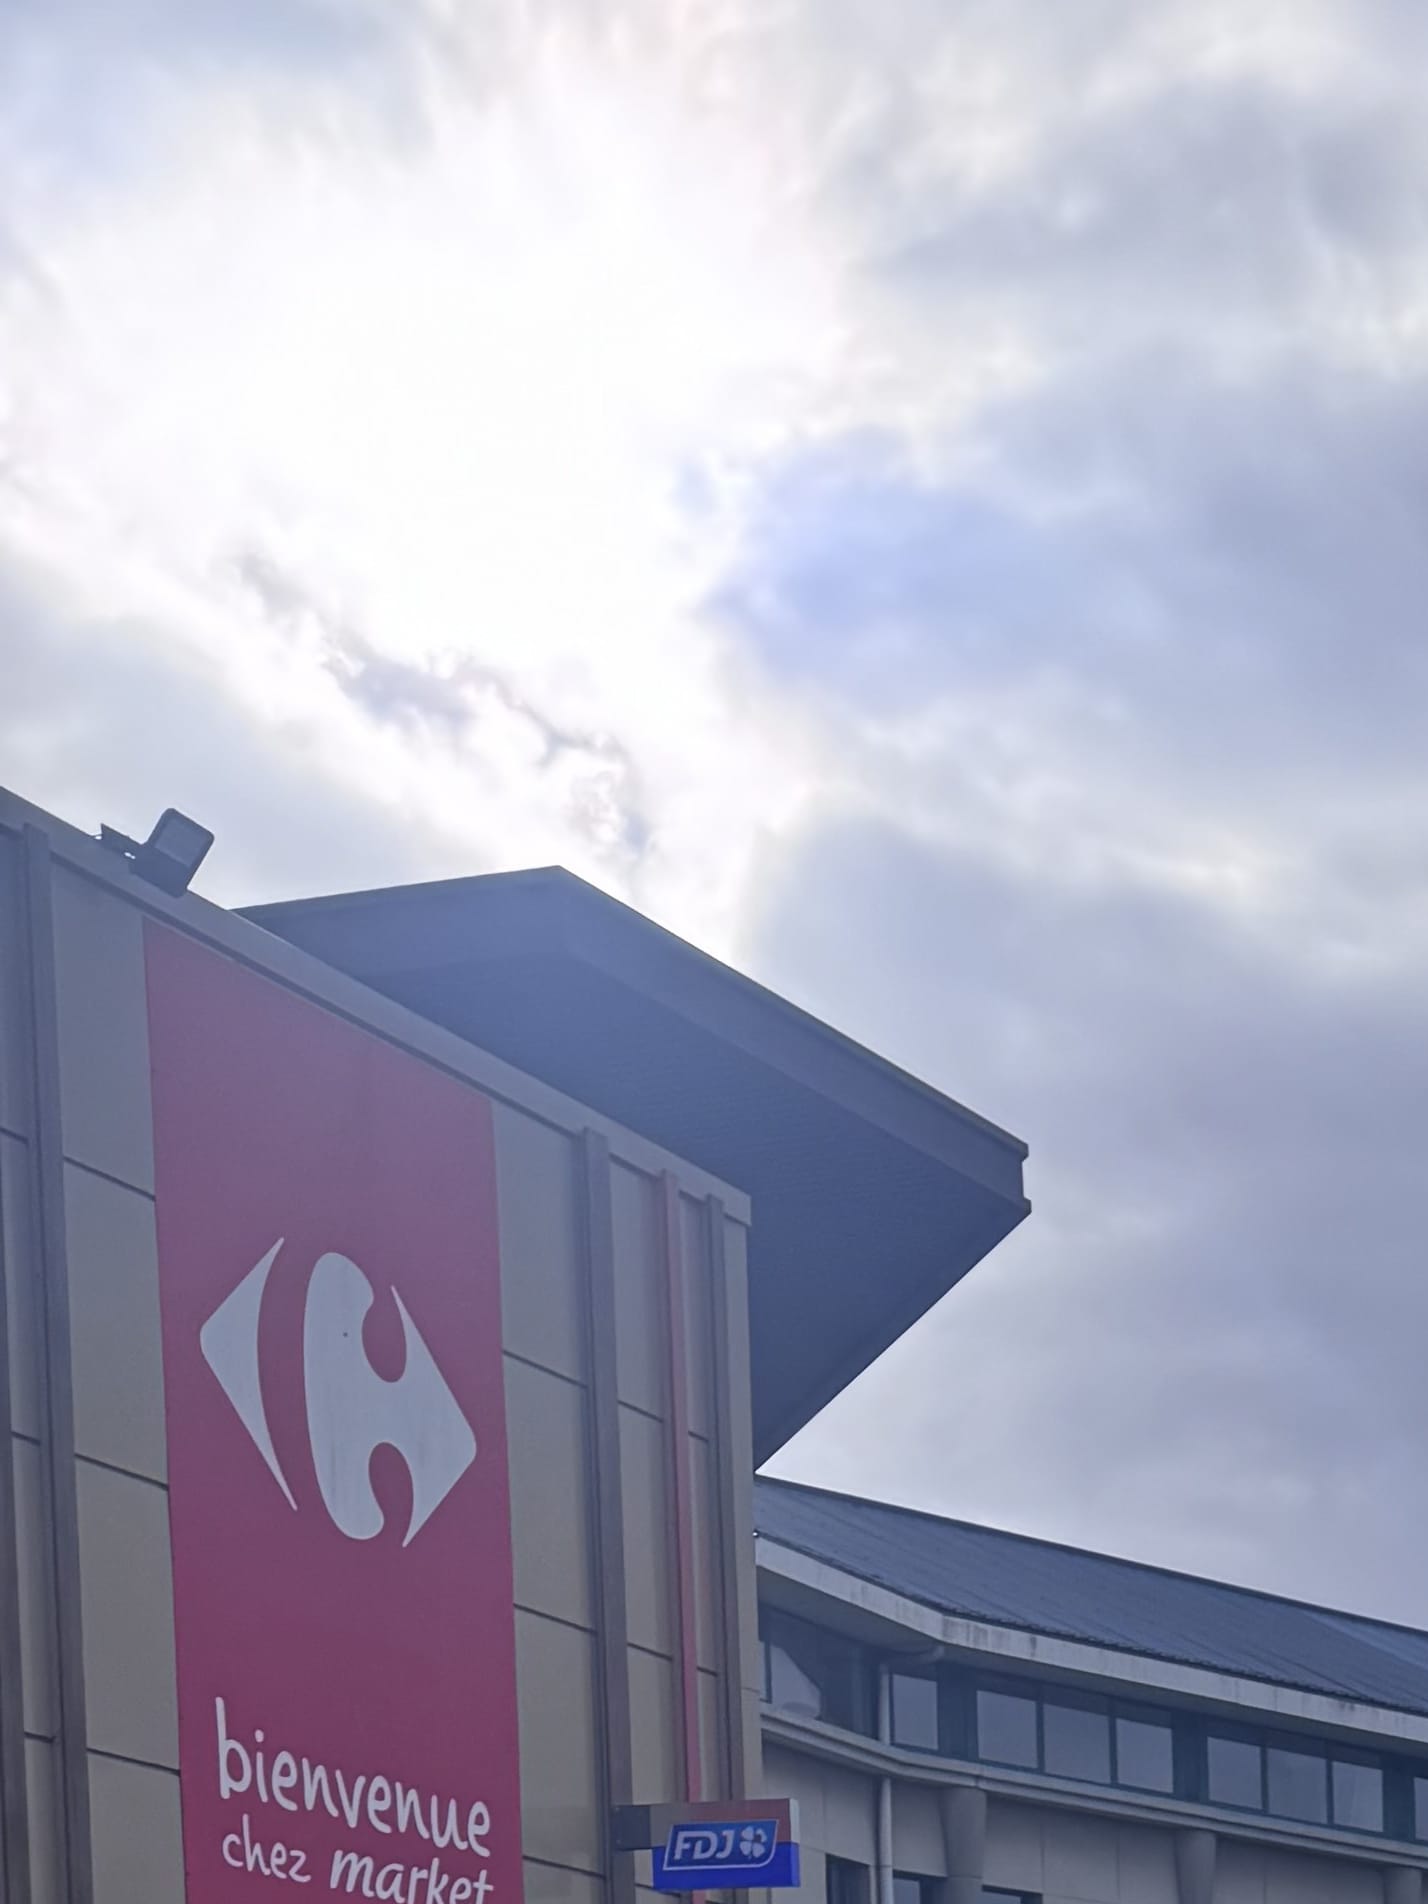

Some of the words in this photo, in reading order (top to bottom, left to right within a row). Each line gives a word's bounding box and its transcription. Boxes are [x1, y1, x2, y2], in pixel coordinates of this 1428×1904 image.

[215, 1696, 491, 1858] bienvenue
[222, 1813, 312, 1883] chez
[674, 1829, 735, 1860] FDJ
